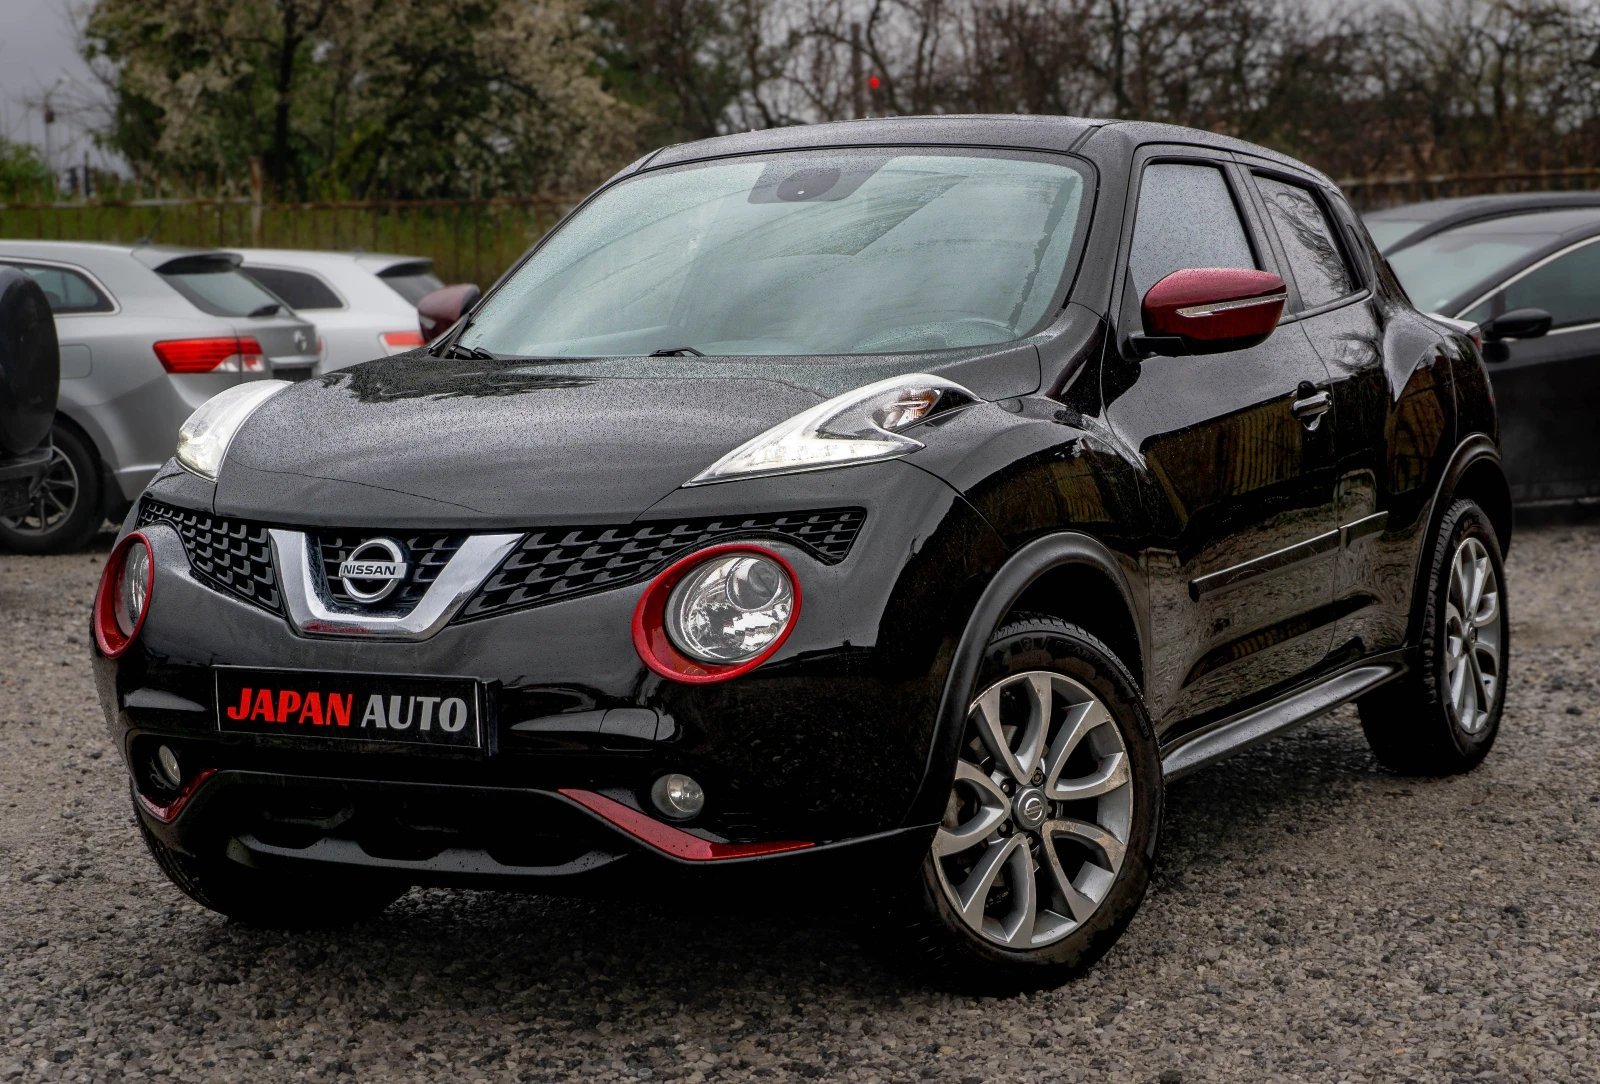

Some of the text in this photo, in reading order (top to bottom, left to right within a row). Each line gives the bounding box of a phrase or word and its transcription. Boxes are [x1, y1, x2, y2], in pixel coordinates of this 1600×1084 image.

[343, 565, 397, 576] NISSAN
[227, 688, 468, 732] JAPAN AUTO
